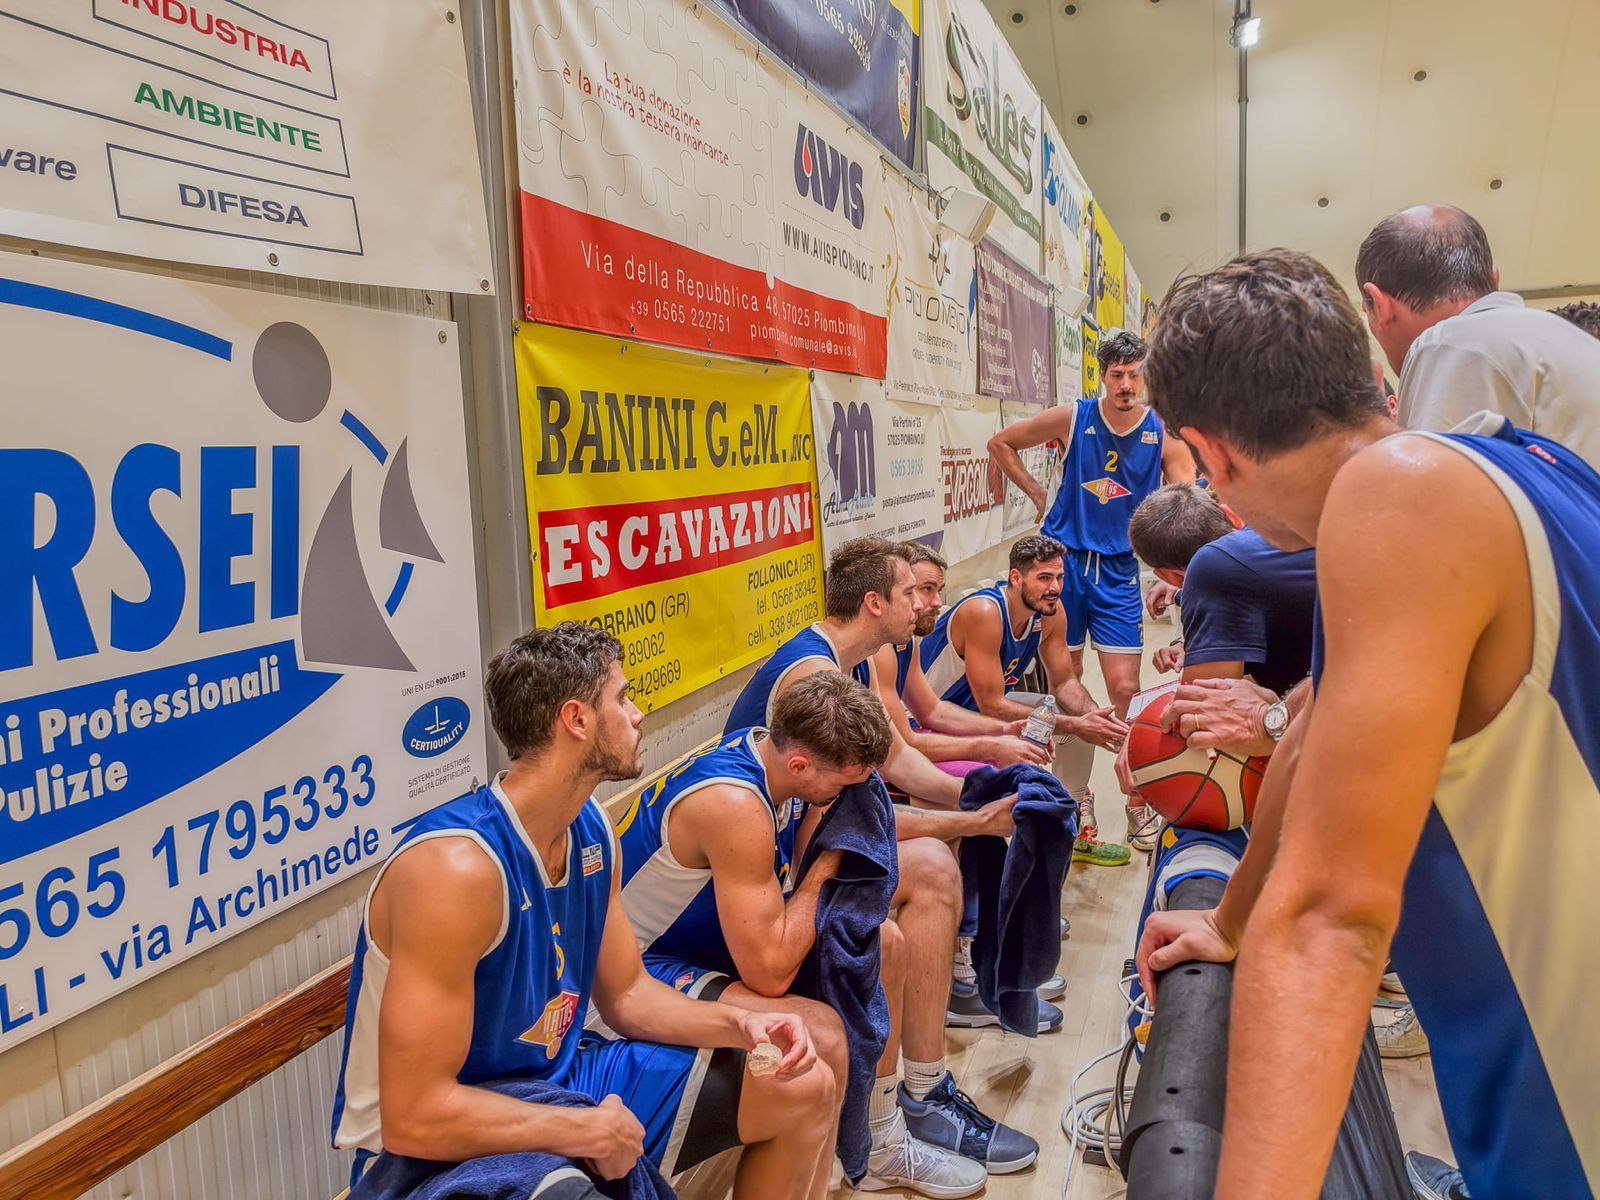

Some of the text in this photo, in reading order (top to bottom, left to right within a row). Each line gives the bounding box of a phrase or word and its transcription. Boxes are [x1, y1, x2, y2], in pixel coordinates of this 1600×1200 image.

[121, 0, 311, 72] NDUSTRIA
[134, 82, 323, 153] AMBIENTE
[562, 60, 730, 167] è la nostra tessera mancante
[604, 62, 701, 133] La tua donazione
[793, 123, 866, 230] AVIS
[178, 183, 309, 228] DIFESA
[581, 240, 614, 275] Via
[625, 255, 669, 290] della
[676, 268, 759, 313] Repubblica
[630, 300, 649, 317] +39
[654, 299, 686, 324] 0565
[691, 308, 731, 333] 222751
[536, 386, 697, 475] BANINI
[1104, 450, 1119, 473] 2
[545, 492, 811, 587] ESCAVAZIONI
[748, 558, 799, 592] FOLLONICA
[661, 591, 690, 625] (GR)
[747, 601, 819, 647] cell. 338 9021023
[757, 594, 770, 616] tel.
[772, 586, 794, 610] 0566
[628, 631, 665, 667] 89062
[39, 654, 281, 754] Professionali
[401, 670, 466, 697] UNI EN ISO 9001:2015
[410, 721, 463, 751] CERTIQUALITY
[408, 754, 471, 788] SISTEMA DI GESTIONE
[434, 765, 471, 785] CERTIFICATO
[152, 753, 376, 889] 1795333
[100, 924, 172, 980] via
[185, 822, 380, 945] Archimede
